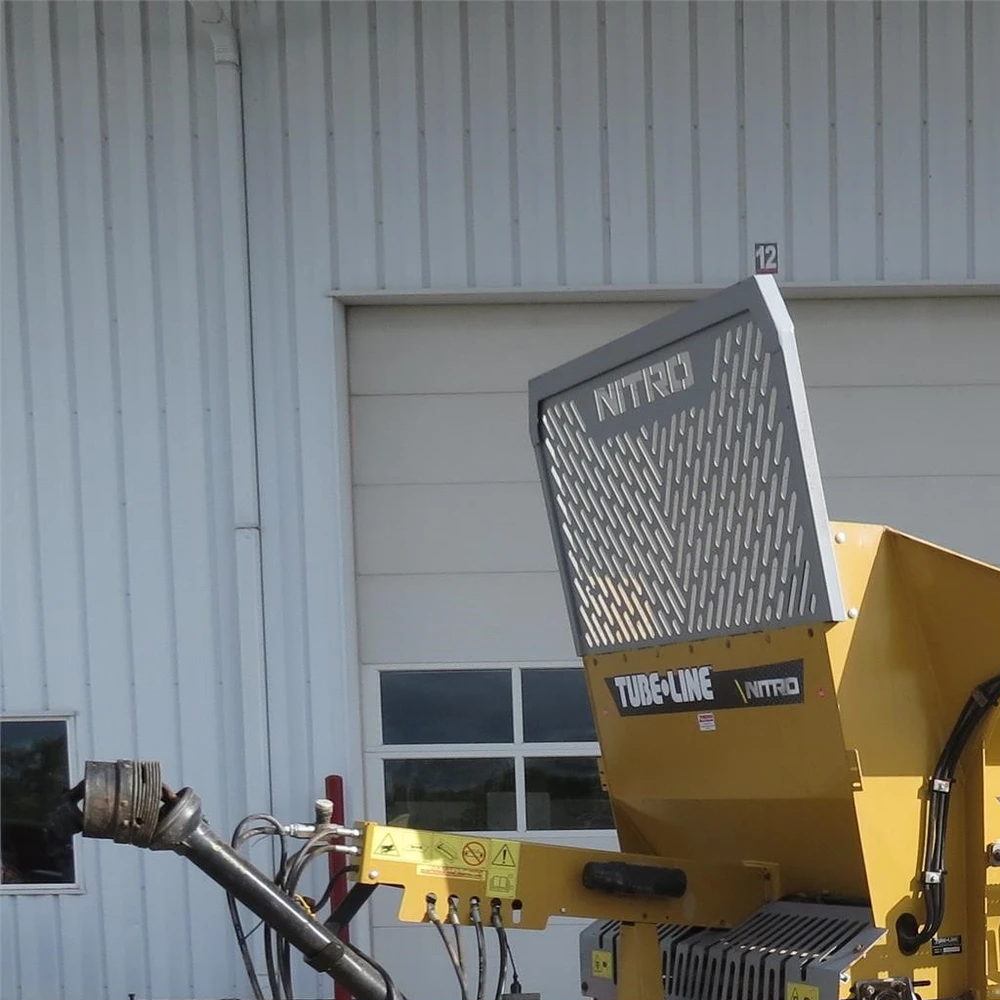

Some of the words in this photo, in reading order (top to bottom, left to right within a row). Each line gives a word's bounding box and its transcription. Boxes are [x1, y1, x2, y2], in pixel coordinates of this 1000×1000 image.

[756, 245, 777, 269] 12
[593, 351, 695, 421] NITRO
[745, 677, 800, 700] NITRO
